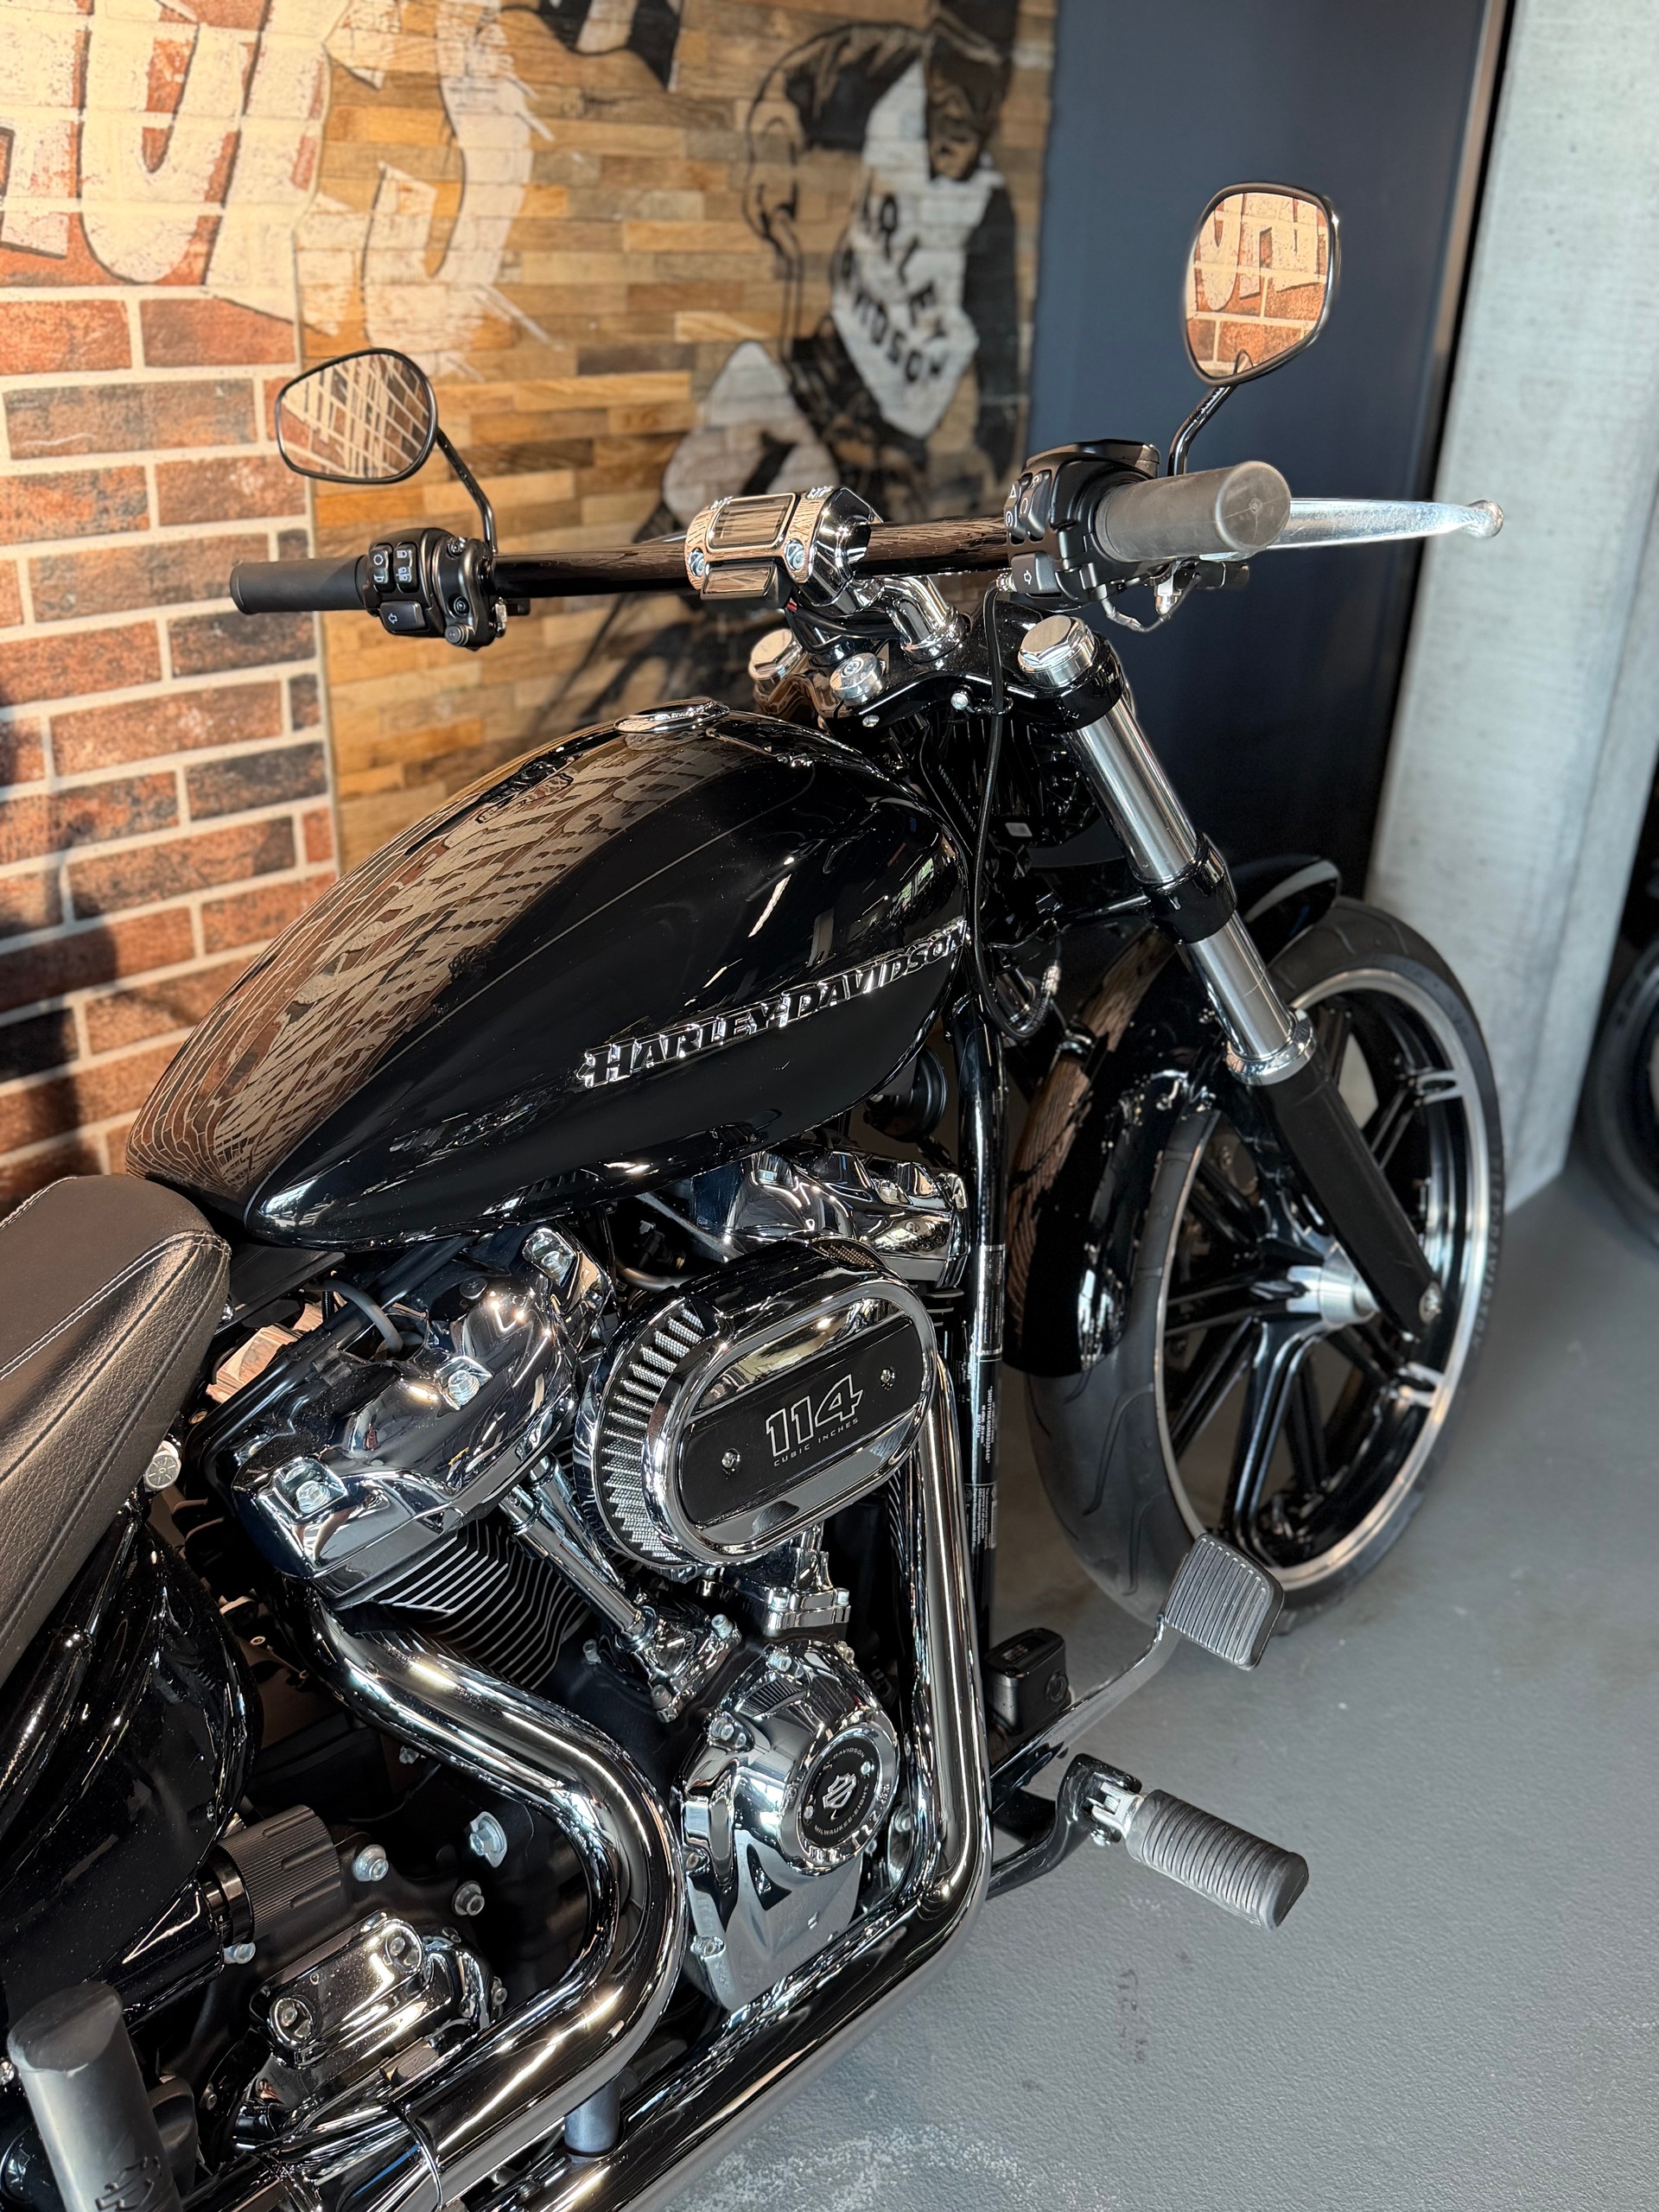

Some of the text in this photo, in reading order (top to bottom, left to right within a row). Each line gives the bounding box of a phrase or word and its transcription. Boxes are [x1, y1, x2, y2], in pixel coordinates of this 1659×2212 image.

[577, 918, 967, 1088] HARLEY-DAVIDSON
[1471, 1142, 1502, 1350] LEY-DAVIDSON
[766, 1374, 863, 1458] 114
[774, 1418, 859, 1466] CUBIC INCHES
